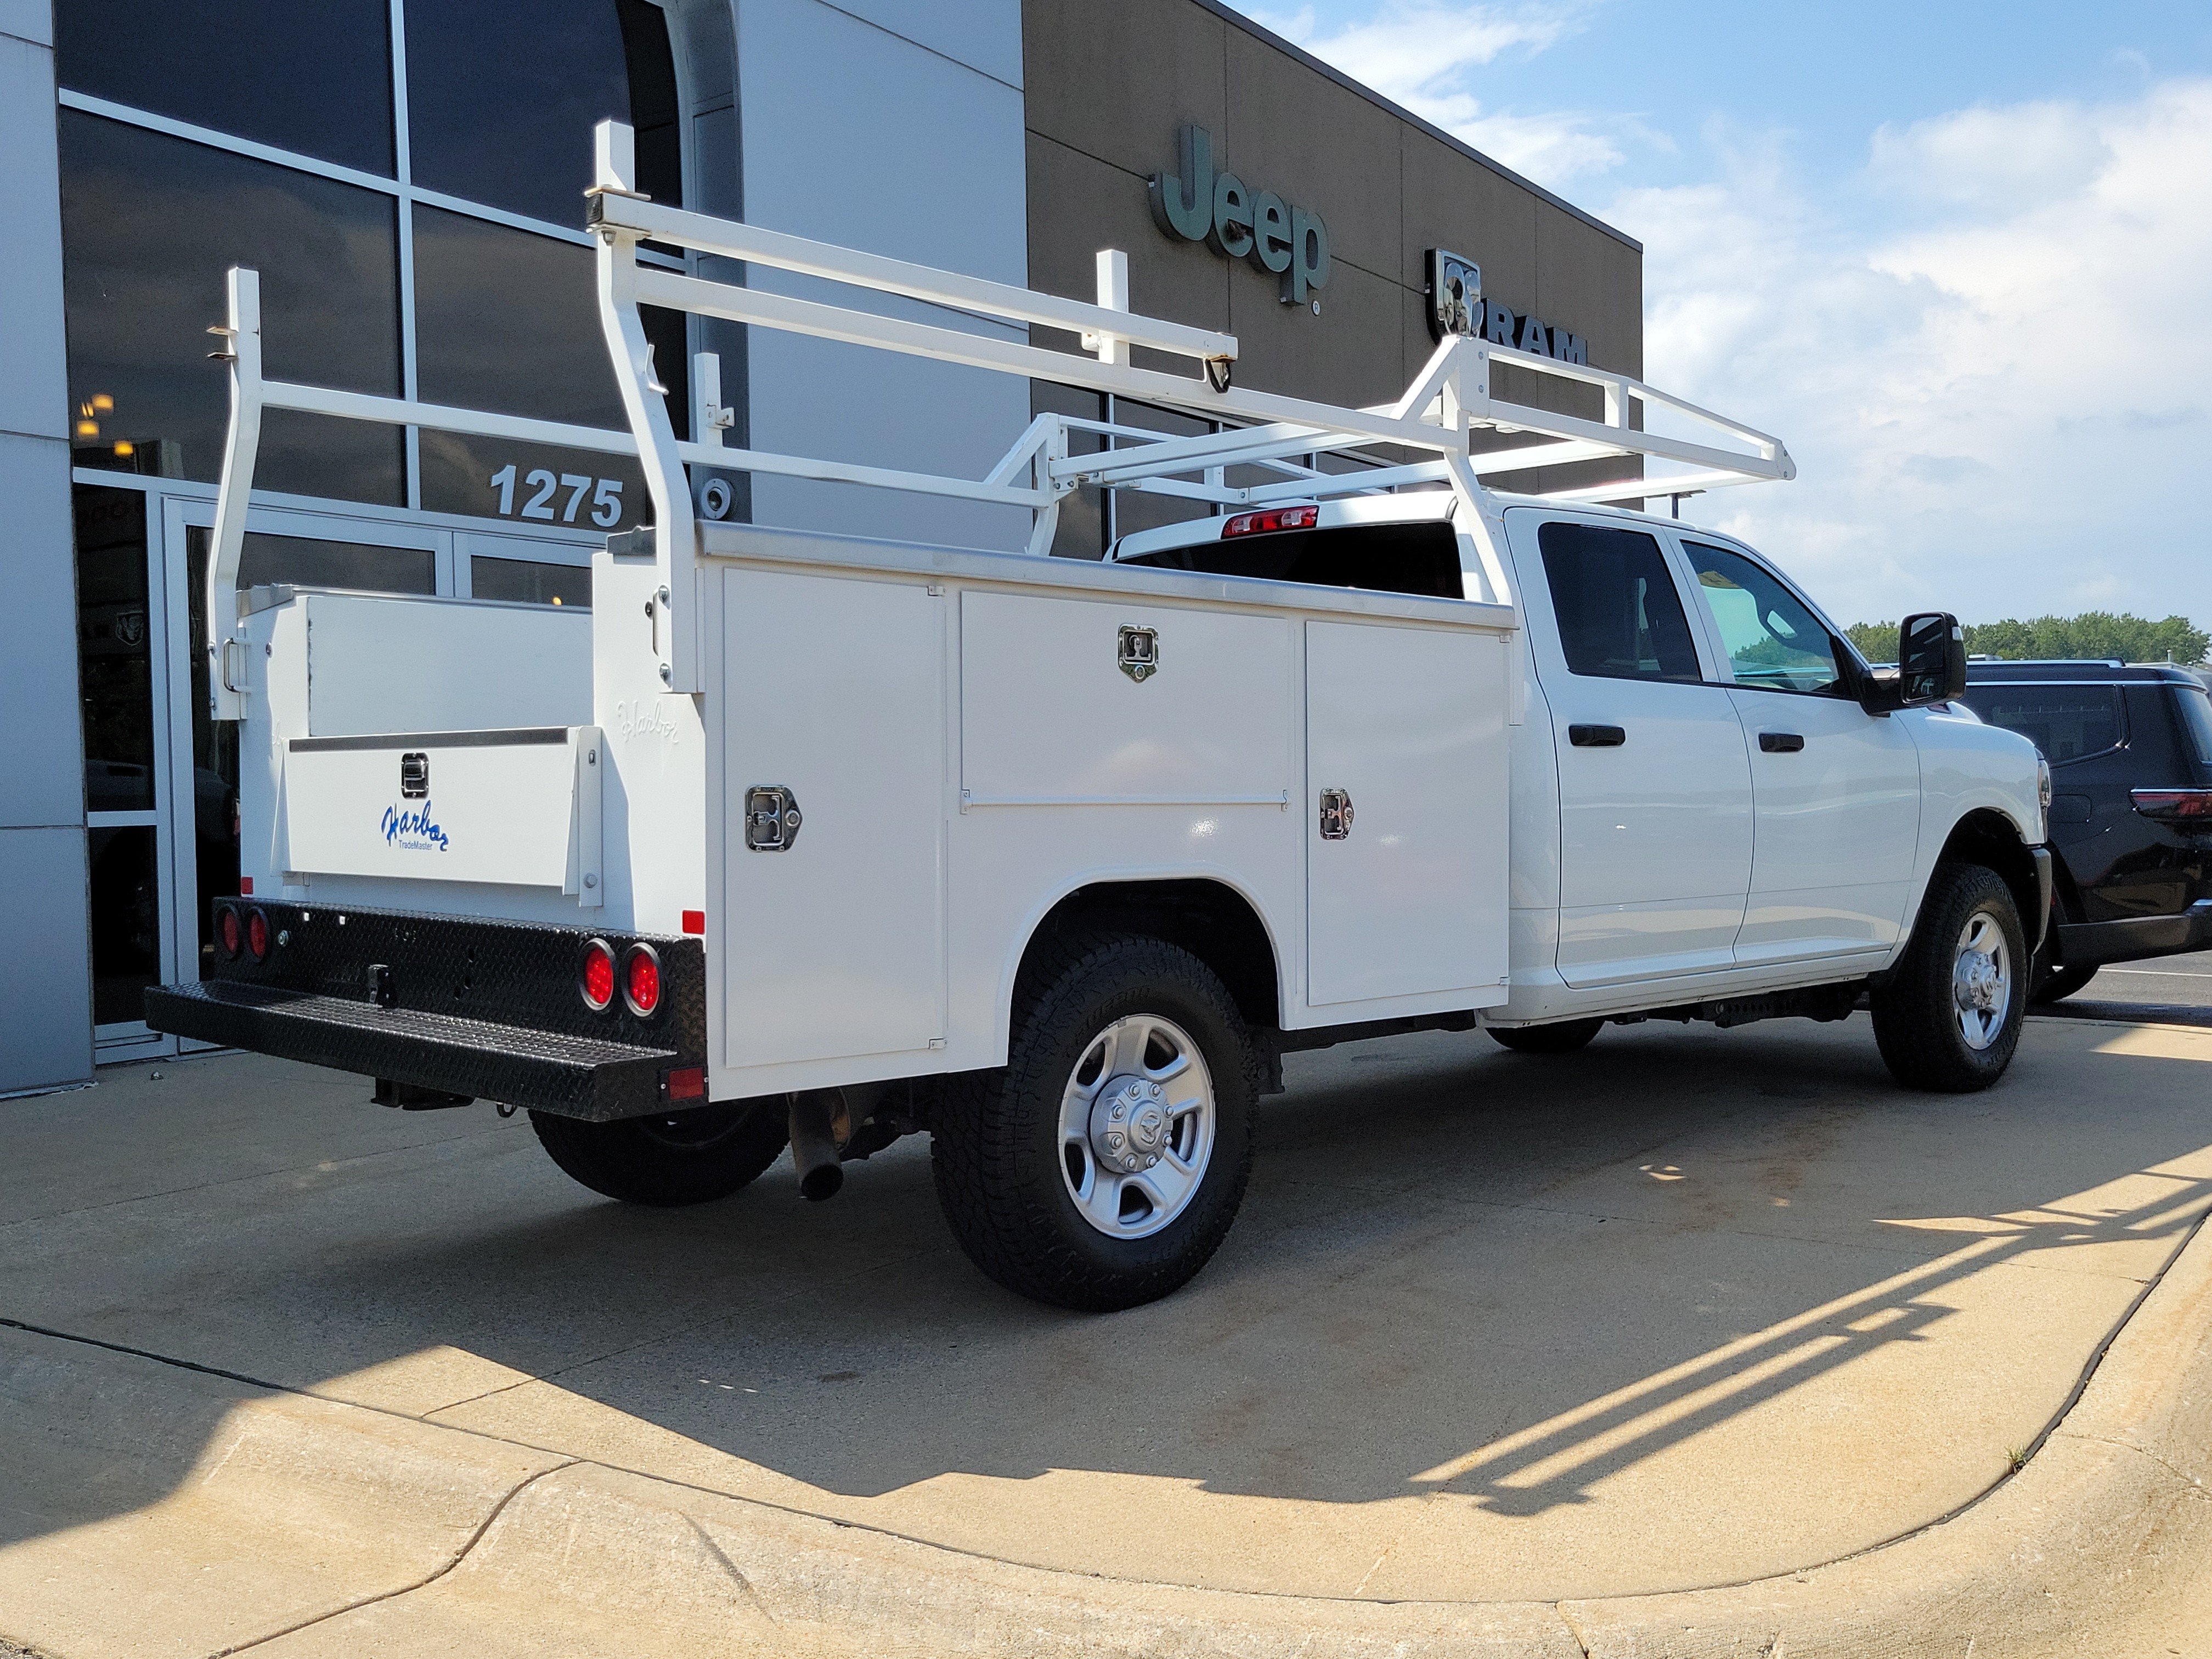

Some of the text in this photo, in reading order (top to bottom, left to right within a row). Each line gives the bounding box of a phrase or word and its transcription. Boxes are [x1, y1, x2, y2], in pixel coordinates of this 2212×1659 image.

[1150, 125, 1330, 306] Jeep
[1483, 297, 1588, 366] RAM
[490, 464, 623, 527] 1275
[617, 698, 680, 745] Harbor
[381, 799, 449, 852] Harbor
[399, 839, 432, 850] TradeMaster
